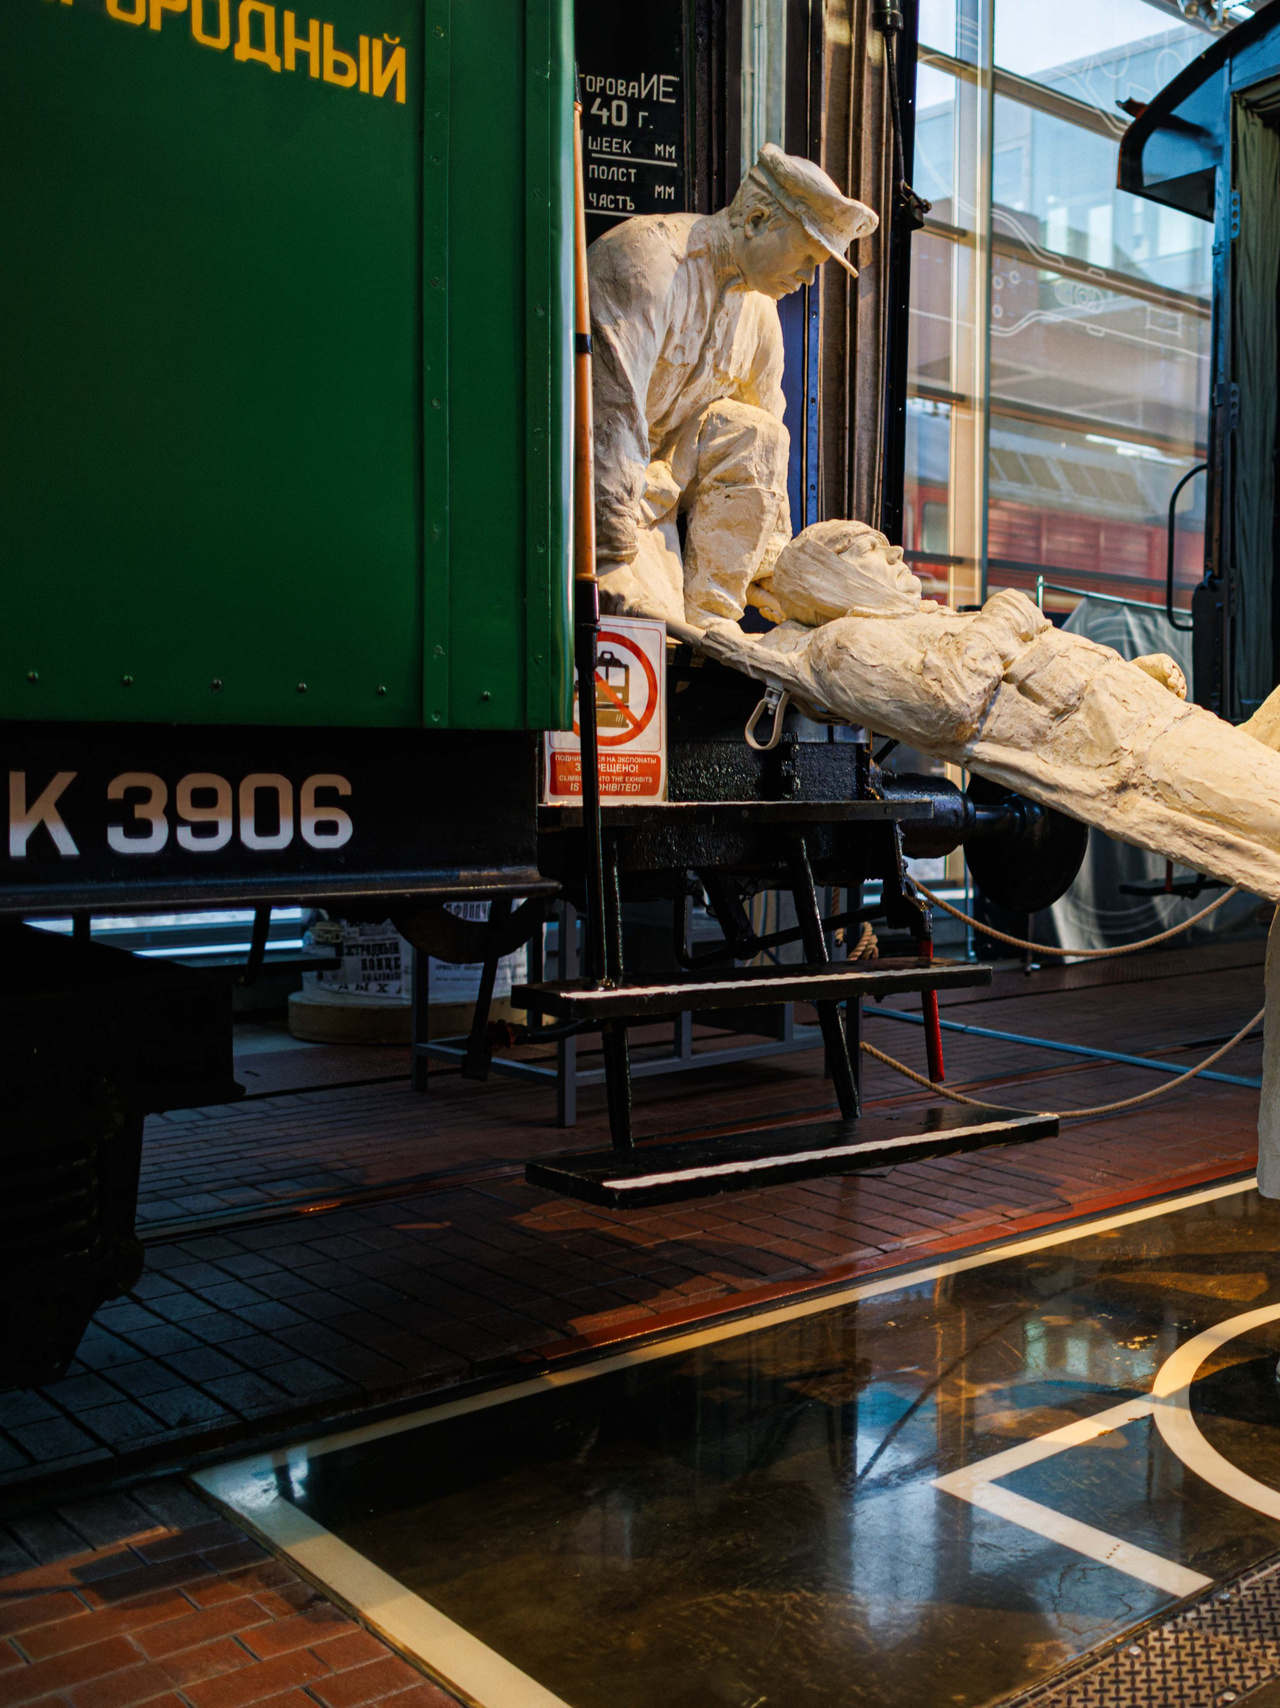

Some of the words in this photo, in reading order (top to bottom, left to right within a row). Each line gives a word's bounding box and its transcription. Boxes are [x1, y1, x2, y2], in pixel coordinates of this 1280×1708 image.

[590, 98, 628, 127] 40
[588, 136, 632, 154] ШЕЕК
[588, 164, 637, 183] ПОЛСТ
[617, 756, 657, 765] ЭКСПОНАТЫ
[570, 782, 580, 791] IS
[612, 775, 624, 783] THE
[625, 776, 653, 784] EXHIBITS
[107, 772, 353, 854] 3906
